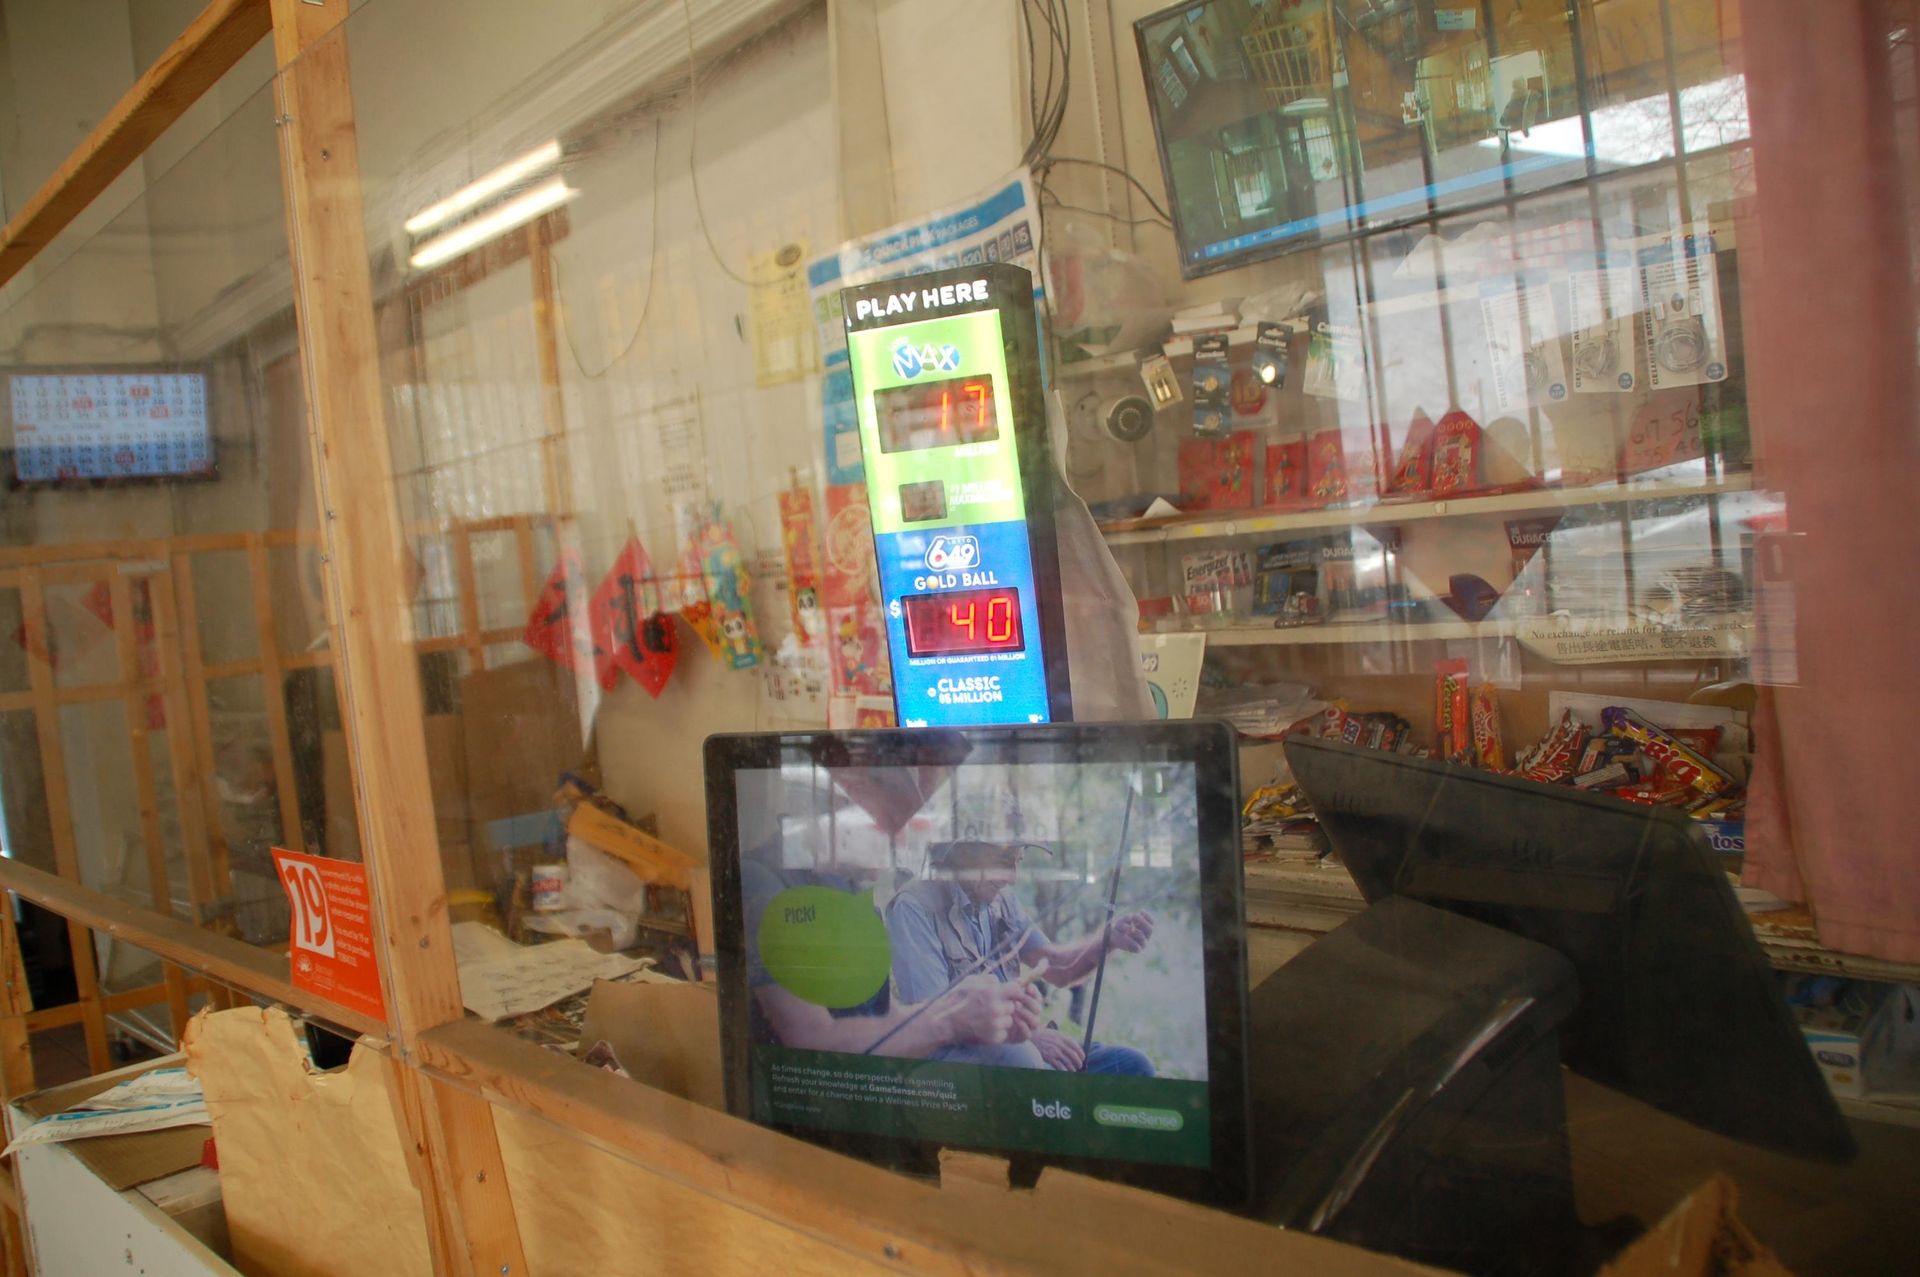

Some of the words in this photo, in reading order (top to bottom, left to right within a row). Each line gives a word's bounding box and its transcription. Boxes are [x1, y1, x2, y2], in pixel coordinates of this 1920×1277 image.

[856, 291, 917, 320] PLAY
[921, 279, 990, 309] HERE
[893, 345, 960, 378] MAX
[940, 383, 986, 432] 17
[928, 536, 976, 568] 649
[1186, 555, 1230, 580] Energizer
[914, 574, 957, 591] GOLD
[962, 570, 999, 587] BALL
[889, 599, 901, 618] $
[951, 597, 1012, 642] 40
[1532, 630, 1545, 640] No
[1548, 629, 1592, 642] exchange
[1606, 626, 1640, 636] refund
[1641, 624, 1657, 634] for
[937, 676, 1001, 692] CLASSIC
[953, 691, 1003, 703] MILLION
[284, 865, 329, 947] 19
[833, 1070, 843, 1078] so
[843, 1070, 854, 1079] do
[868, 1085, 958, 1100] GameSense.com/quiz
[1031, 1098, 1072, 1120] bclc
[1099, 1108, 1178, 1127] GameSense
